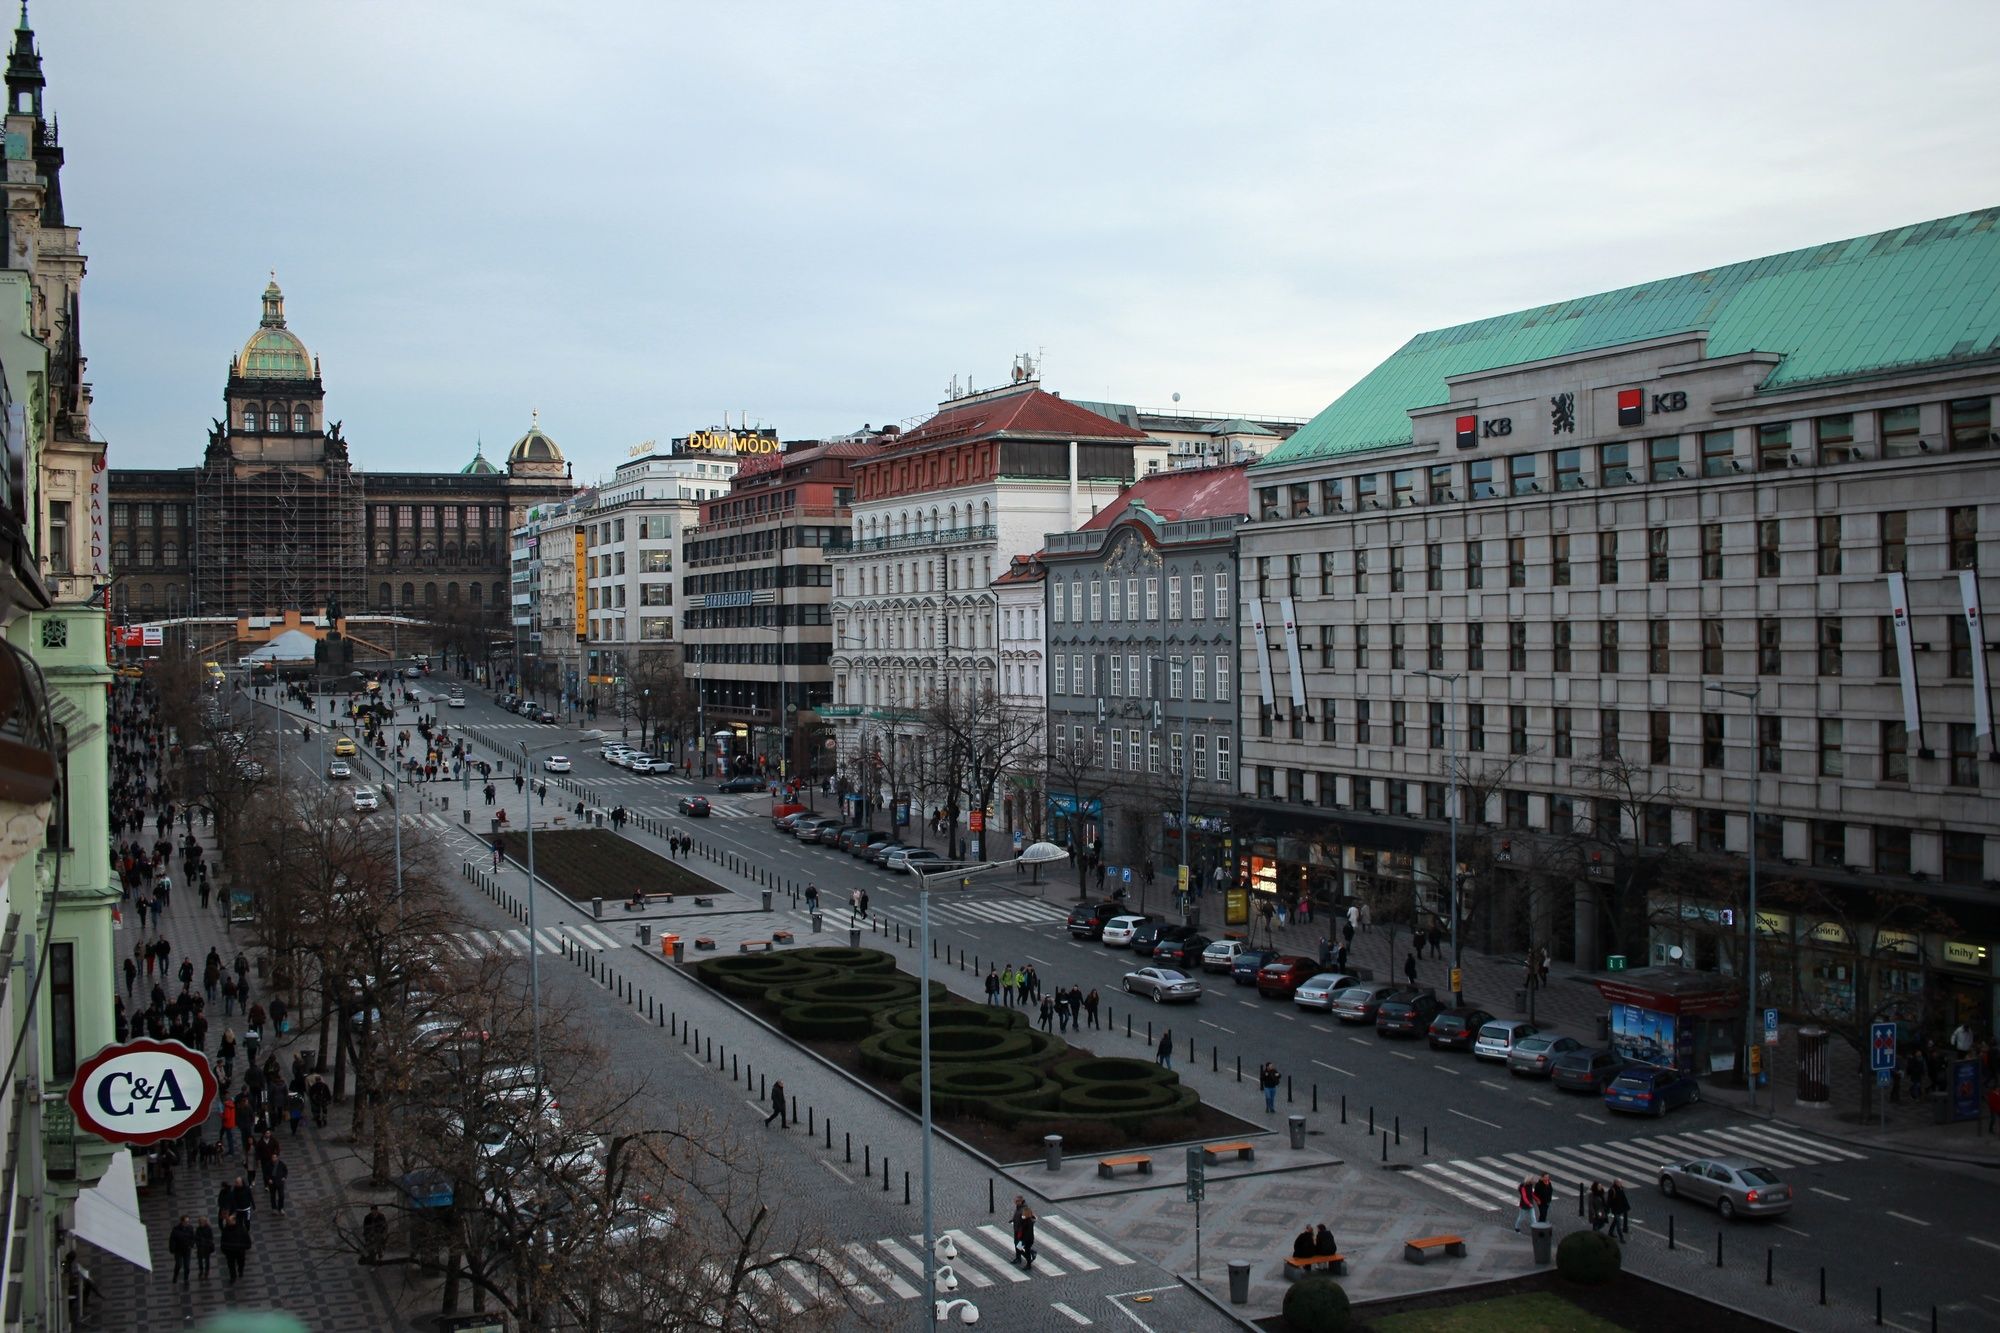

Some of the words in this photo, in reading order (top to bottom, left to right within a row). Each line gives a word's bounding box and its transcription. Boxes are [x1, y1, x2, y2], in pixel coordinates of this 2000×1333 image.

[1651, 391, 1687, 414] KB
[1483, 417, 1512, 438] KB
[689, 429, 728, 450] DŮM
[91, 483, 102, 573] RAMADA
[1949, 946, 1974, 959] knihy
[97, 1068, 192, 1116] C&A
